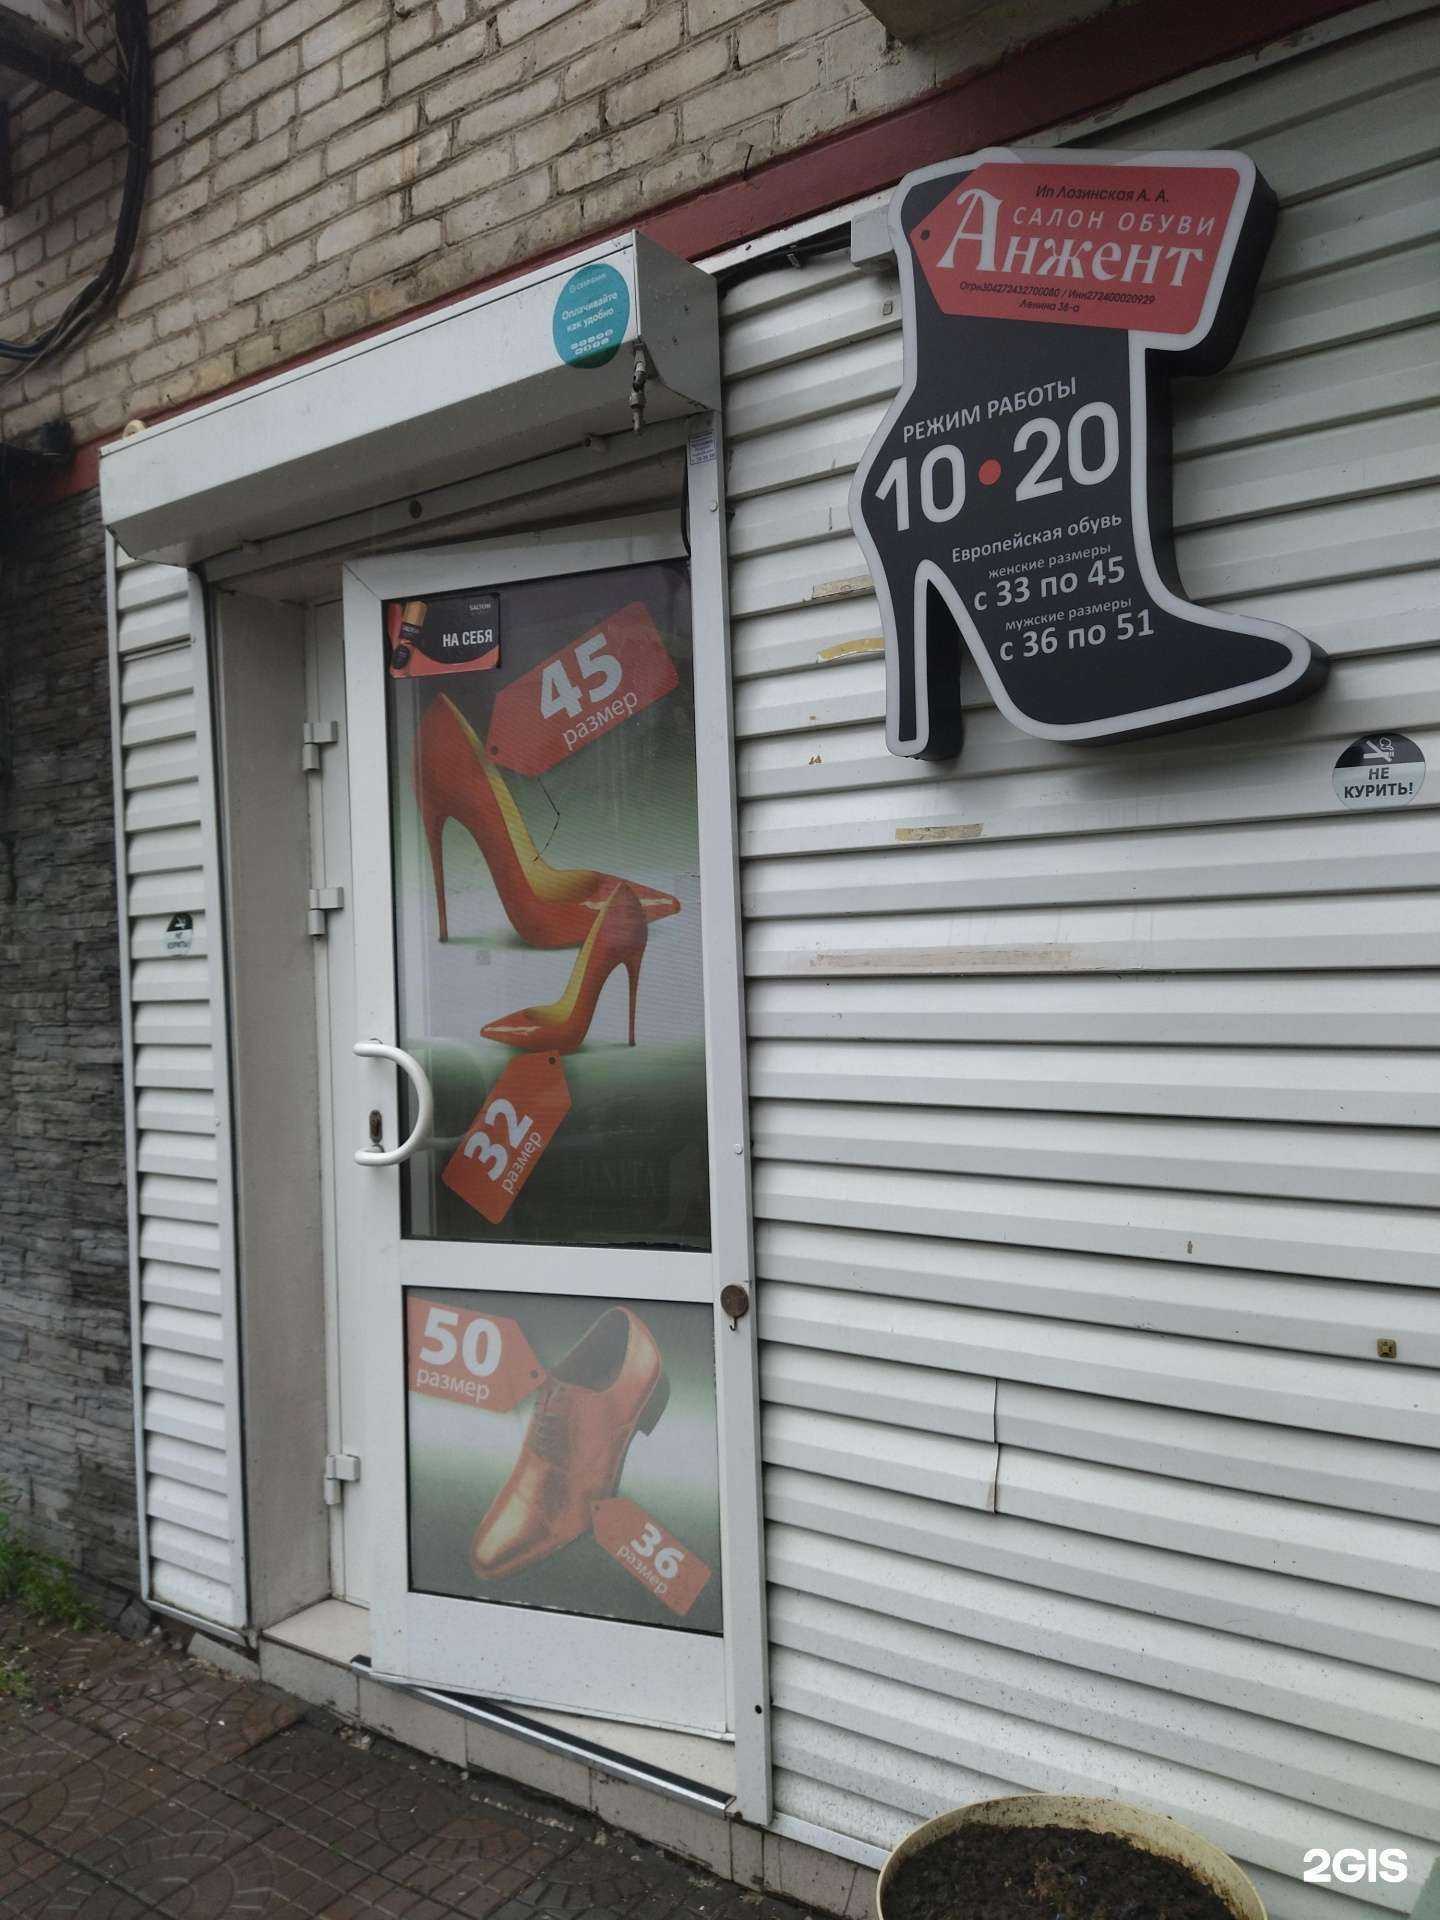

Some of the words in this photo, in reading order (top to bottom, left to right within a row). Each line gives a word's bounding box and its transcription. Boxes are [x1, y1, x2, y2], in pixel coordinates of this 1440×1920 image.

[1013, 206, 1105, 229] САЛОН
[1118, 212, 1216, 236] ОБУВИ
[562, 292, 618, 320] Оплачивайте
[566, 321, 582, 332] как
[583, 308, 614, 328] удобно
[903, 405, 981, 443] РЕЖИМ
[987, 376, 1077, 419] РАБОТЫ
[875, 444, 966, 532] 10
[1013, 401, 1120, 502] 20
[952, 526, 1062, 563] Европейская
[1067, 513, 1122, 538] обувь
[988, 557, 1045, 580] женские
[1048, 544, 1112, 568] размеры
[996, 576, 1031, 607] 33
[1040, 572, 1078, 598] по
[1087, 555, 1125, 587] 45
[443, 632, 459, 647] НА
[462, 629, 493, 645] СЕБЯ
[1005, 609, 1065, 633] мужские
[1068, 598, 1132, 622] размеры
[1022, 627, 1058, 658] 36
[1068, 624, 1106, 650] по
[1117, 608, 1154, 640] 51
[540, 632, 623, 719] 45
[562, 691, 638, 751] размер
[1344, 782, 1413, 799] КУРИТЬ!
[1368, 767, 1390, 780] НЕ
[463, 1098, 533, 1181] 32
[502, 1132, 543, 1195] размер
[419, 1307, 503, 1377] 50
[416, 1368, 490, 1402] размер
[616, 1545, 668, 1595] размер
[630, 1522, 685, 1578] 36
